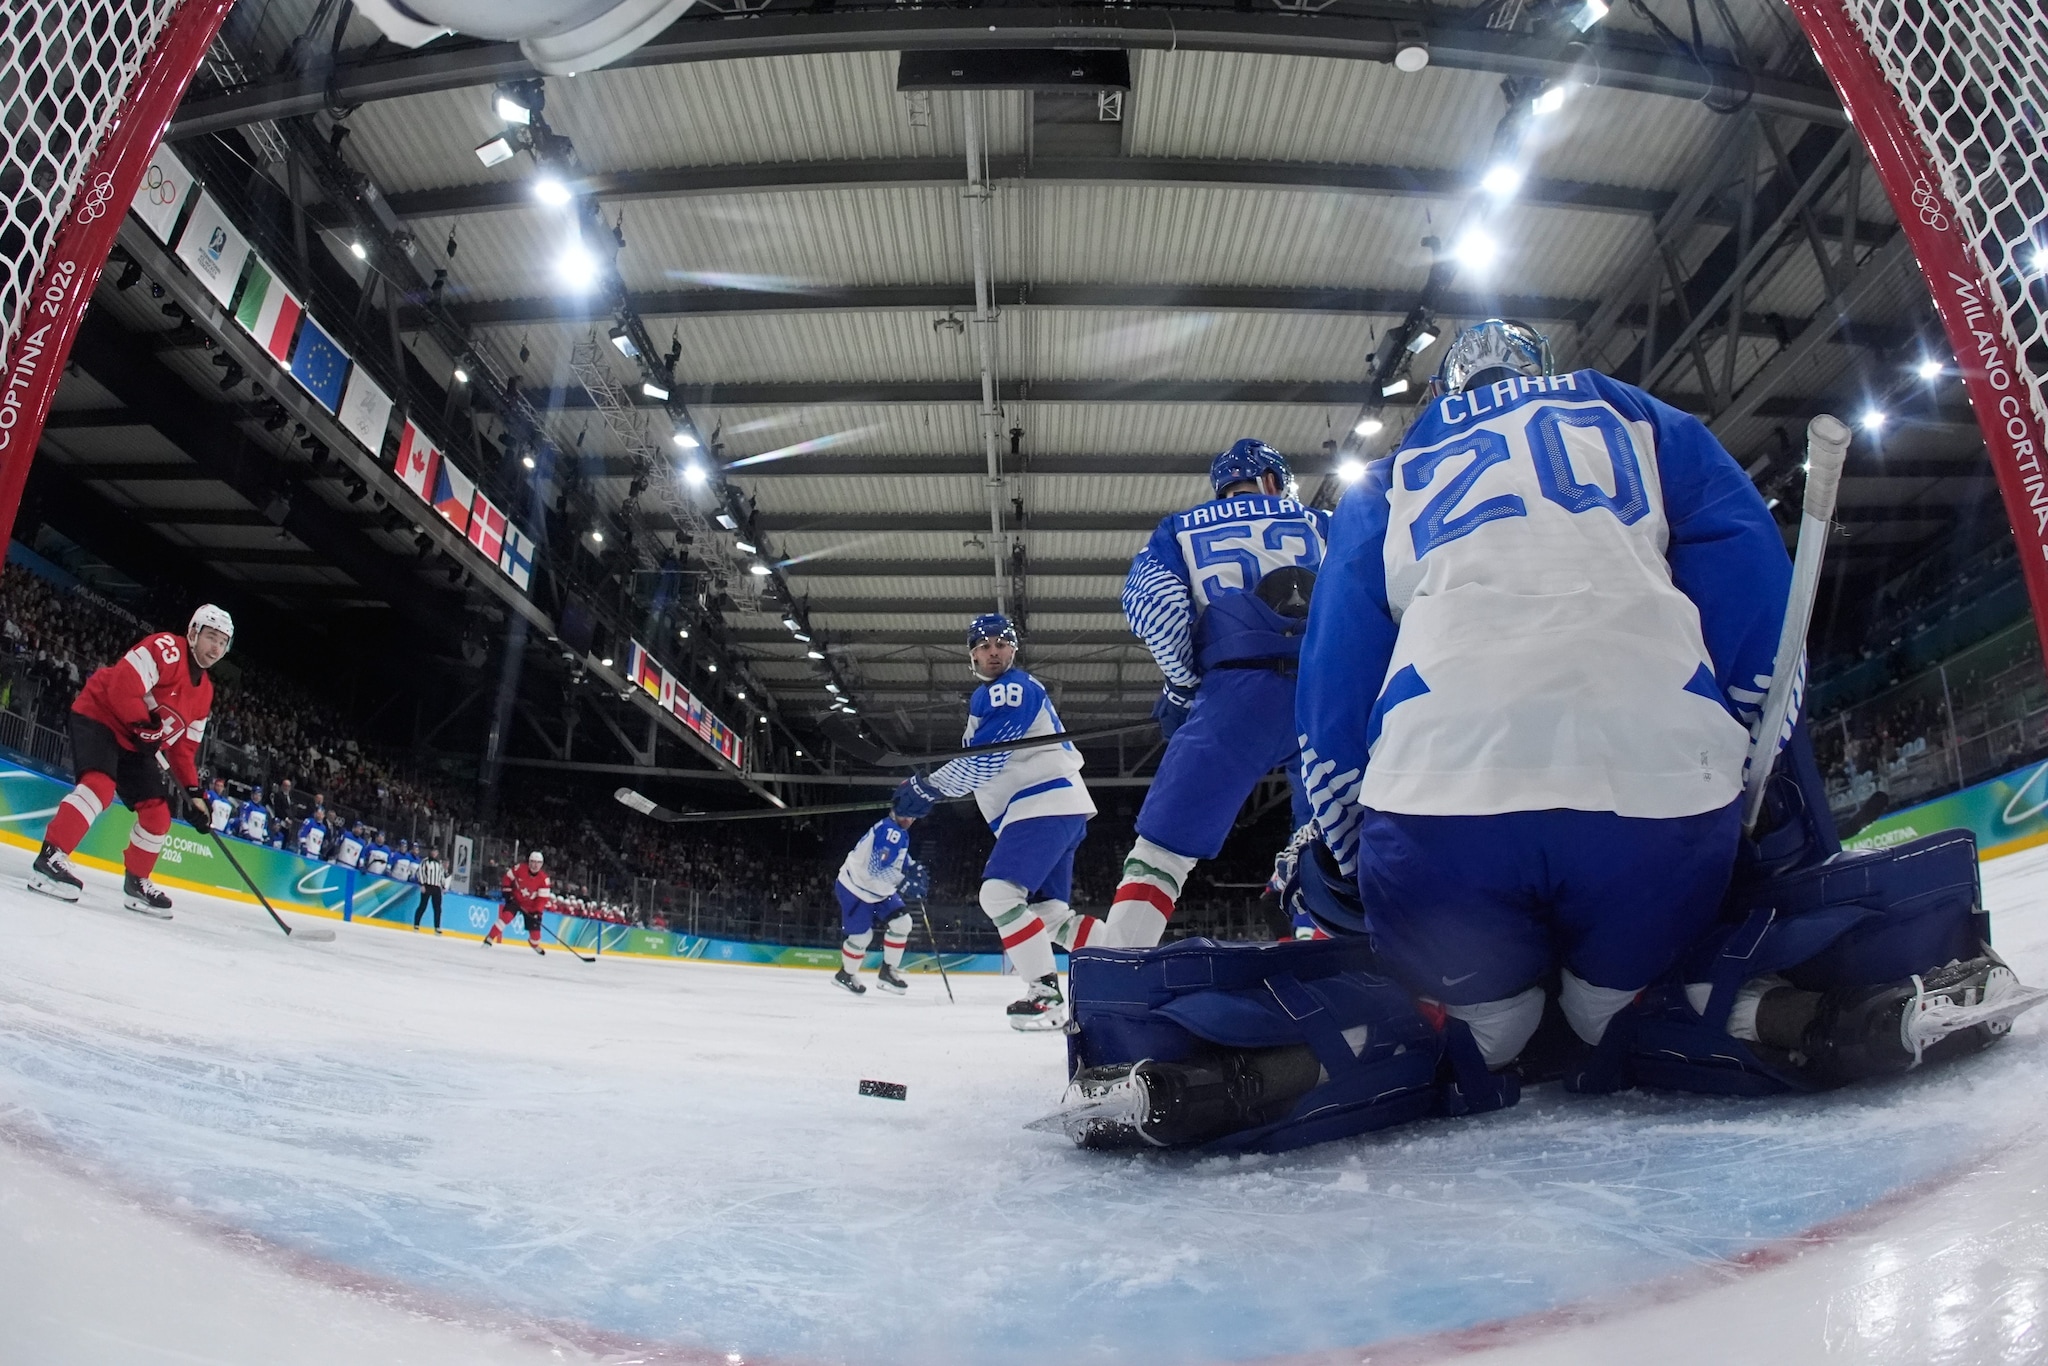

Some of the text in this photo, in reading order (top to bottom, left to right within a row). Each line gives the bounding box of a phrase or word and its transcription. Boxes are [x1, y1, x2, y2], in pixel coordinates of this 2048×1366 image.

[40, 260, 76, 318] 2026
[1948, 270, 2010, 391] MILANO
[1439, 373, 1578, 425] CLARA
[1400, 405, 1651, 562] 20
[154, 634, 181, 665] 23
[988, 682, 1024, 708] 88
[910, 775, 936, 803] CCM
[173, 837, 214, 859] CORTINA
[885, 827, 902, 845] 18
[161, 848, 182, 864] 2026
